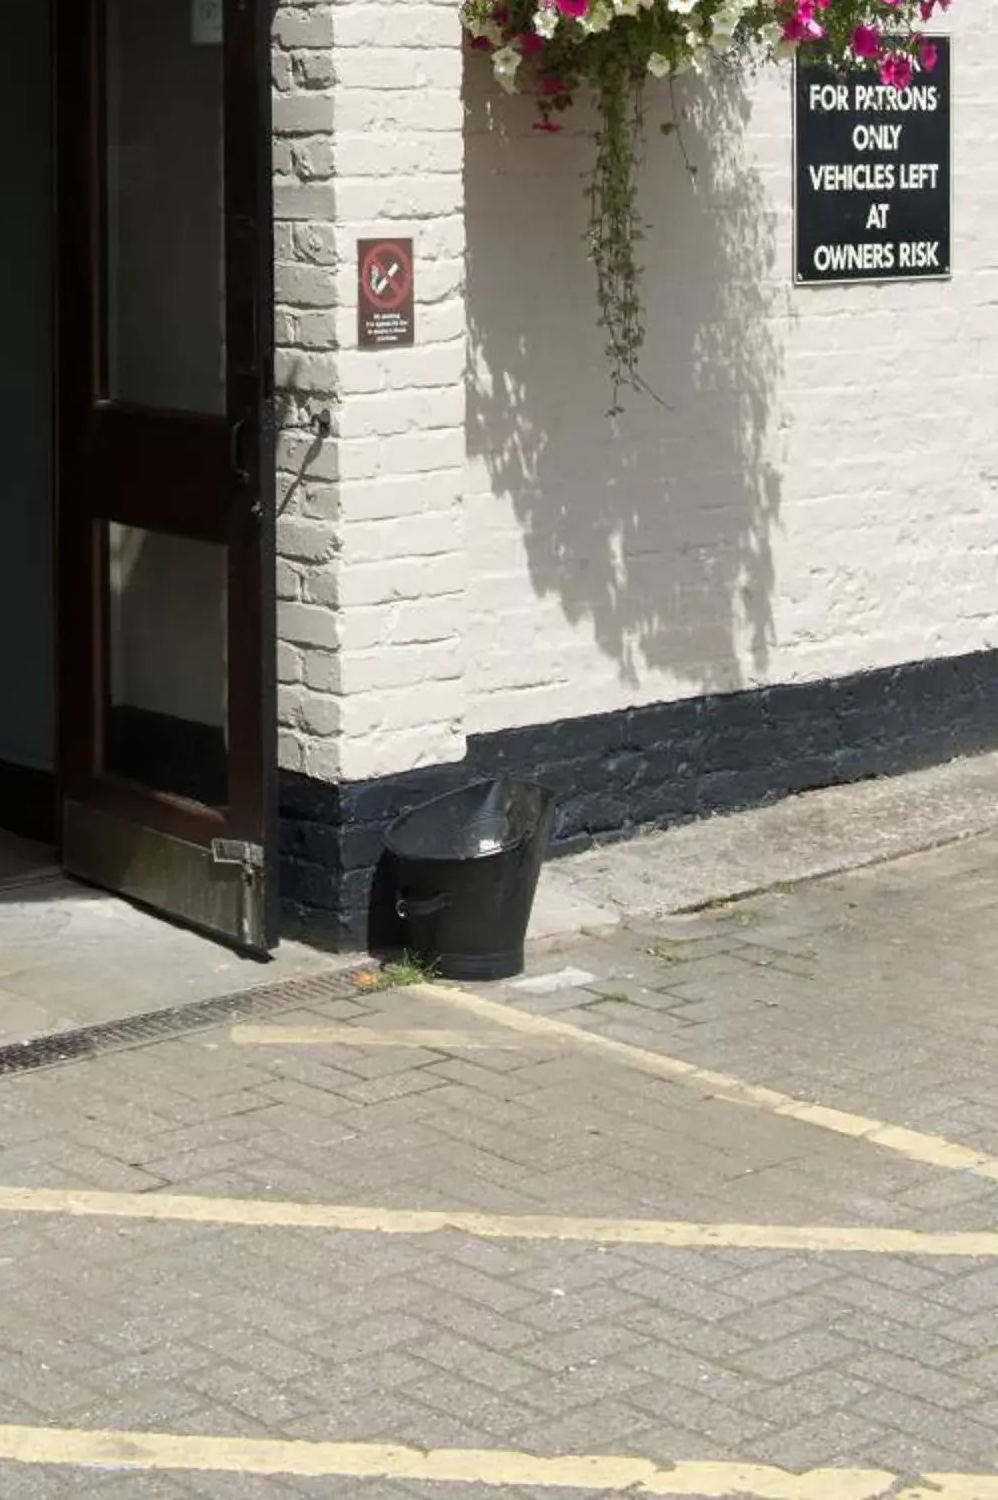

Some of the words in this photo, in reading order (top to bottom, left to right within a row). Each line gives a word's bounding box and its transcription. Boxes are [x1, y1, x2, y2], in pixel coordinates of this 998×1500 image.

[809, 84, 850, 110] FOR
[855, 84, 938, 111] PATRONS
[852, 124, 902, 151] ONLY
[809, 164, 895, 191] VEHICLES
[900, 164, 939, 189] LEFT
[865, 203, 890, 229] AT
[814, 243, 895, 271] OWNERS
[899, 241, 940, 269] RISK
